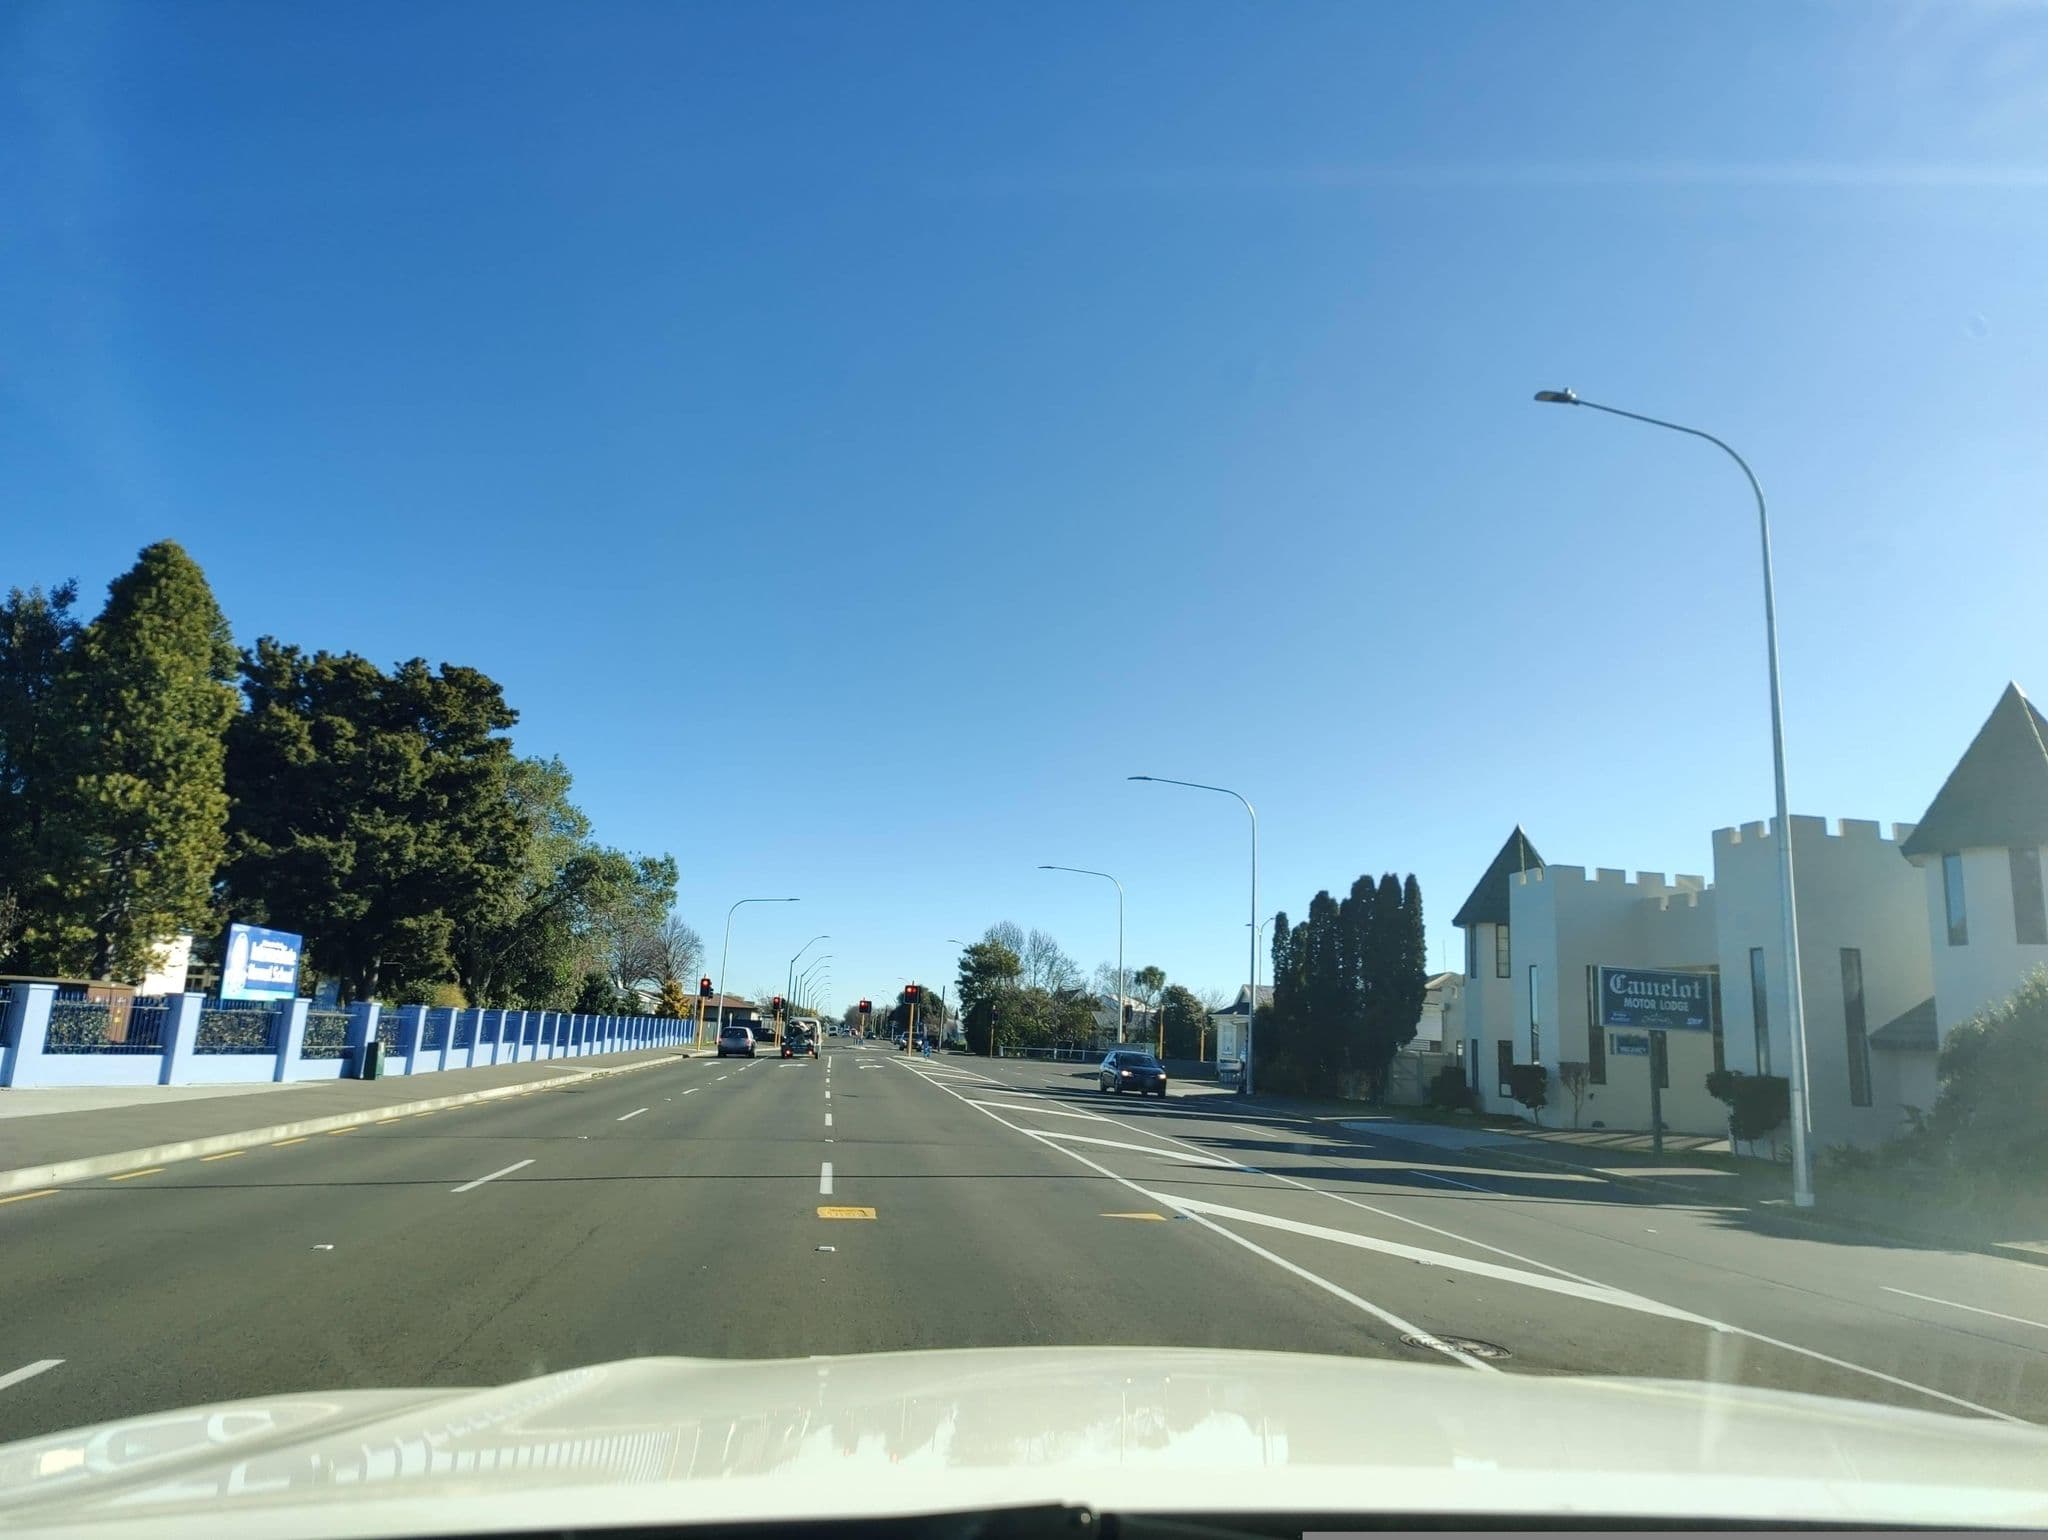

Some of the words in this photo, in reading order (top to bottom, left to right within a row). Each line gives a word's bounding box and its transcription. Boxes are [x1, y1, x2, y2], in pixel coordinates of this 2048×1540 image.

[1609, 973, 1701, 999] Camelot
[1623, 997, 1656, 1010] MOTOR
[1660, 1000, 1689, 1012] LODGE
